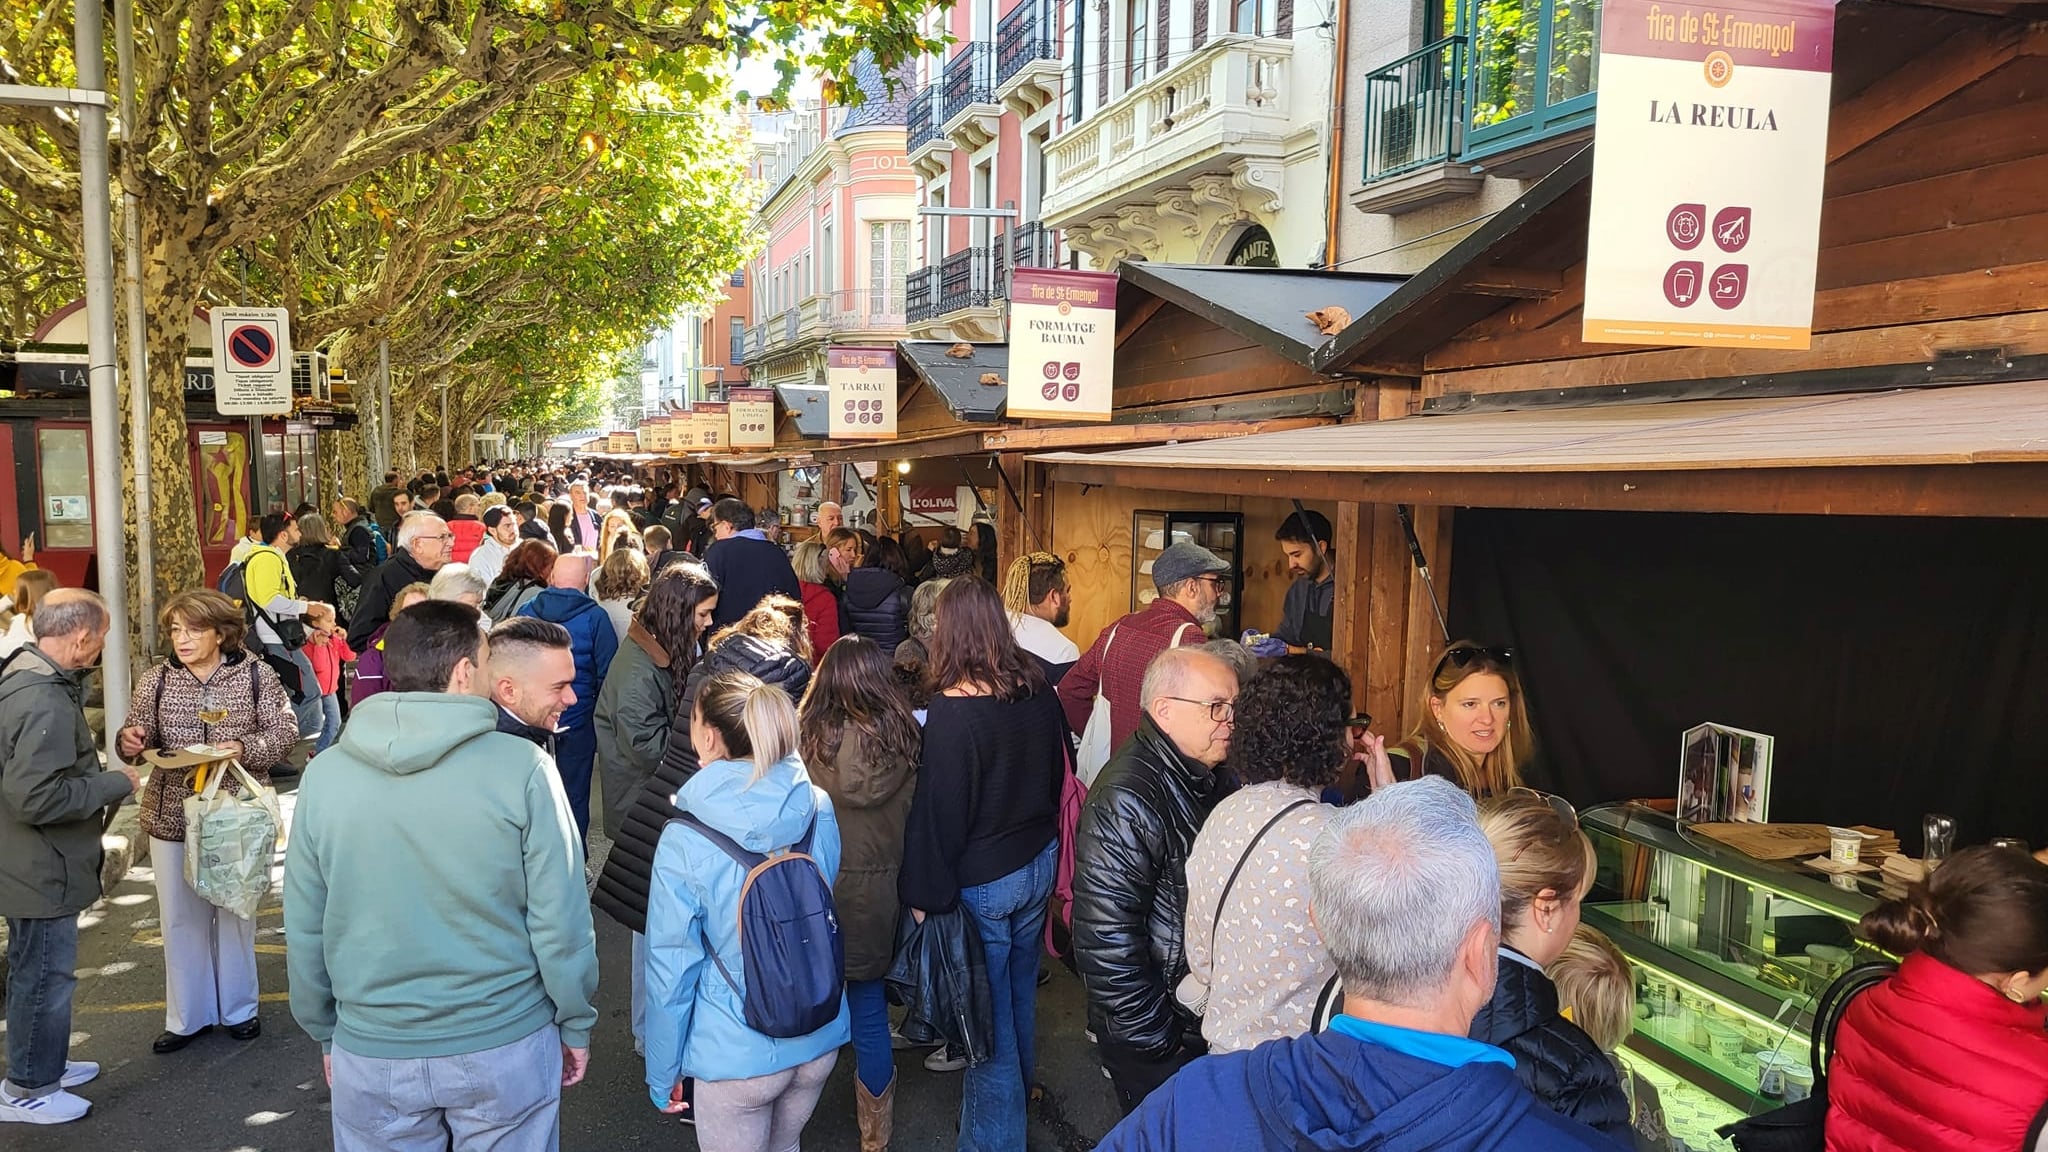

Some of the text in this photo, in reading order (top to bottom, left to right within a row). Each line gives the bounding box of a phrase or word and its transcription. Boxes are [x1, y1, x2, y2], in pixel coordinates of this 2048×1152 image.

[1647, 5, 1674, 42] fira
[1679, 11, 1698, 44] de
[1649, 100, 1778, 131] LA REULA
[1031, 283, 1044, 299] fira
[1045, 285, 1055, 299] de
[1029, 319, 1096, 334] FORMATGE
[1041, 333, 1085, 345] BAUMA
[58, 369, 215, 390] LA RD
[840, 382, 886, 392] TARRAU
[912, 497, 955, 509] L'OLIVA
